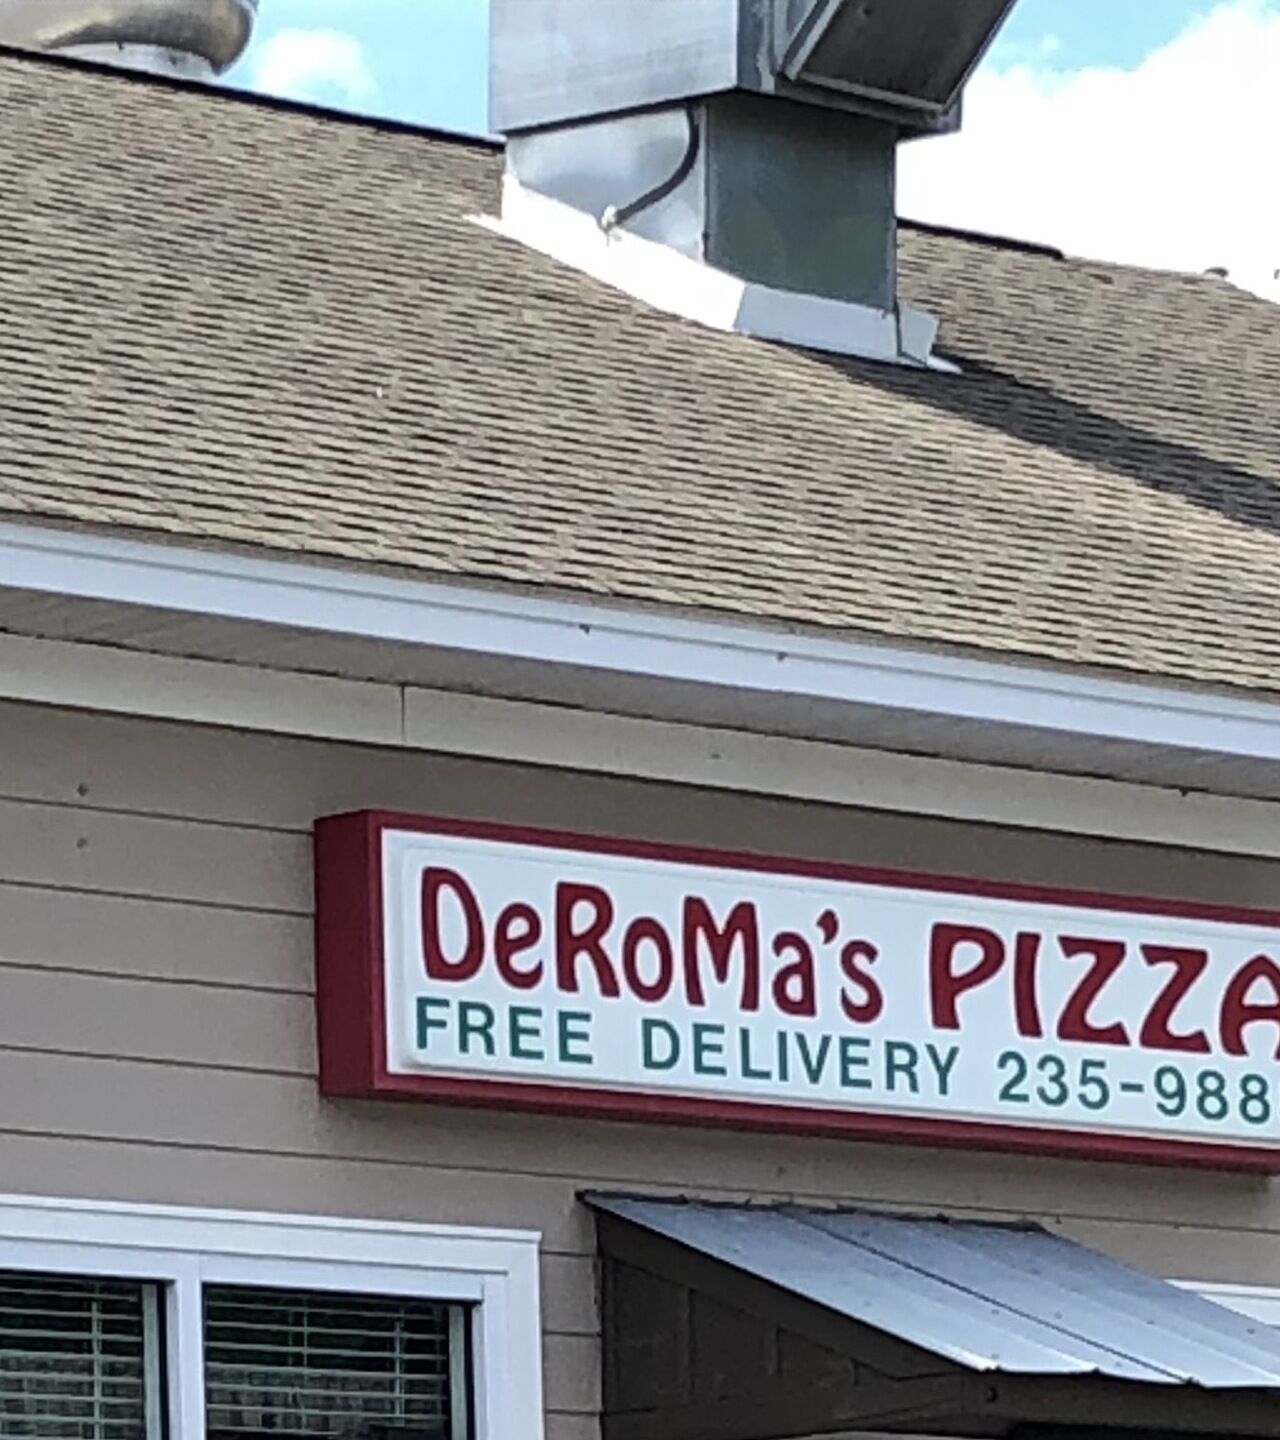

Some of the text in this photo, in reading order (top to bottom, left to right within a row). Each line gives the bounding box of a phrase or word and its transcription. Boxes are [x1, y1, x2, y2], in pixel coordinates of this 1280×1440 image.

[420, 866, 880, 1025] DeRoMa's
[415, 996, 595, 1066] FREE
[641, 1018, 960, 1096] DELIVERY
